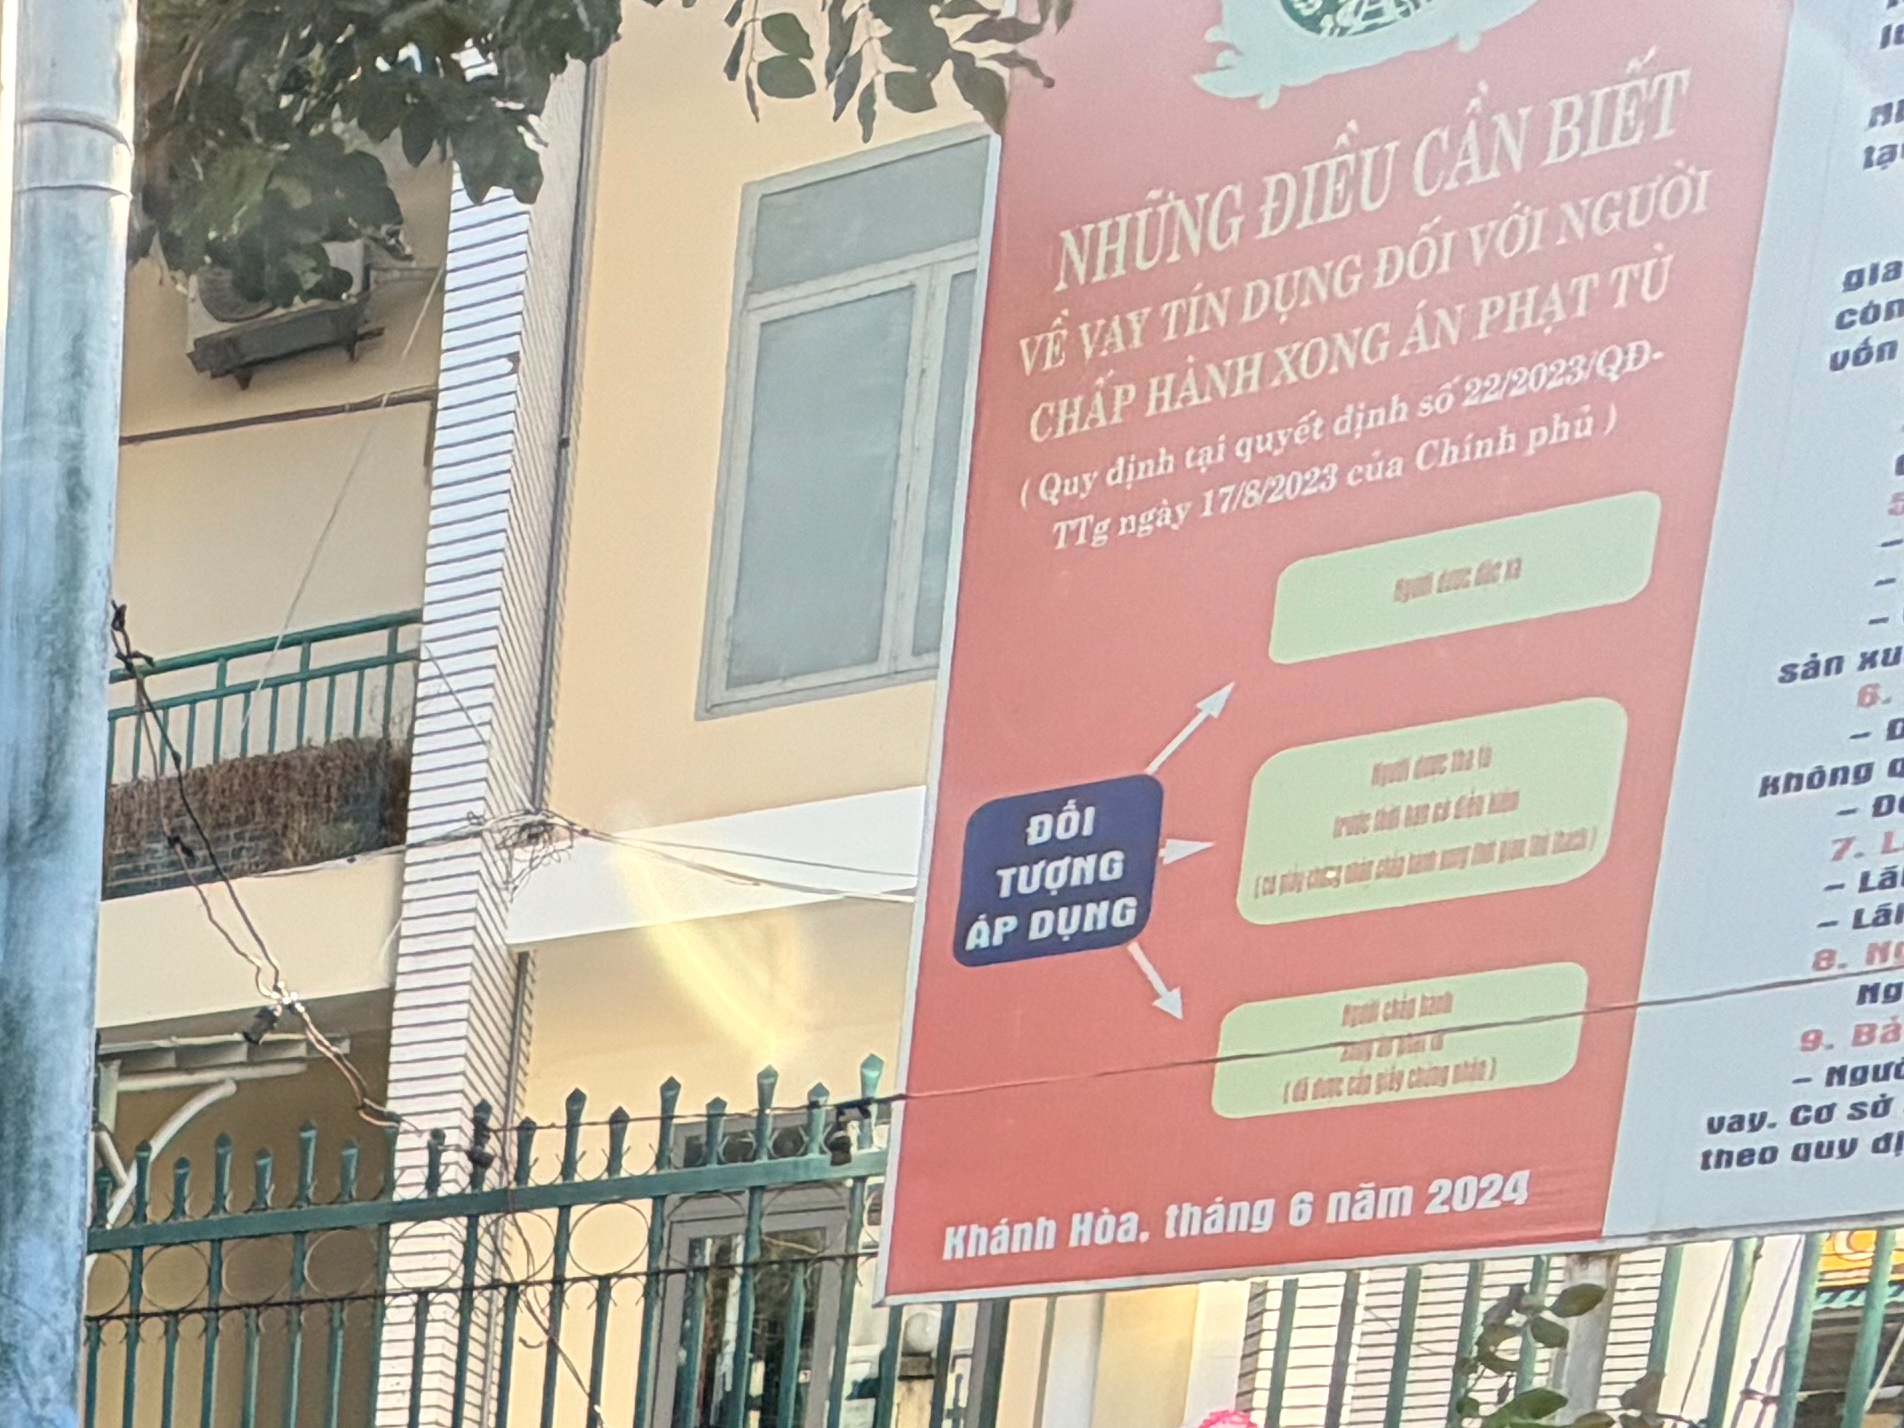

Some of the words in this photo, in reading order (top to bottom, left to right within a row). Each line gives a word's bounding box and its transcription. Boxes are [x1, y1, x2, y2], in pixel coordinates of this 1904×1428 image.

[1054, 181, 1244, 291] NHỮNG
[1256, 119, 1399, 240] ĐIỀU
[1413, 80, 1532, 197] CẦN
[1543, 46, 1692, 166] BIẾT
[1018, 306, 1071, 376] VỀ
[1080, 307, 1150, 366] VAY
[1161, 274, 1233, 345] TÍN
[1239, 254, 1365, 326] DỤNG
[1373, 215, 1455, 290] ĐỐI
[1464, 200, 1546, 268] VỚI
[1556, 159, 1713, 246] NGƯỜI
[1028, 368, 1136, 444] CHẤP
[1144, 354, 1263, 421] HÀNH
[1269, 321, 1392, 389] XONG
[1398, 300, 1467, 359] ÁN
[1476, 274, 1600, 342] PHẠT
[1610, 243, 1676, 309] TÙ
[1038, 469, 1099, 508] Quy
[1106, 444, 1175, 491] định
[1184, 438, 1226, 478] tại
[1235, 416, 1326, 463] quyết
[1333, 393, 1409, 444] định
[1417, 379, 1456, 421] số
[1462, 337, 1664, 409] 22/2023/QĐ-
[1052, 512, 1110, 550] TTg
[1118, 501, 1189, 540] ngày
[1199, 466, 1340, 519] 17/8/2023
[1345, 450, 1403, 490] của
[1414, 424, 1516, 473] Chính
[1527, 403, 1595, 449] phủ
[1778, 652, 1844, 684] sản
[1026, 799, 1096, 846] ĐỐI
[996, 850, 1125, 898] TƯỢNG
[965, 913, 1019, 950] ÁP
[1028, 896, 1138, 942] DỤNG
[1790, 1102, 1837, 1126] Cơ
[1847, 1093, 1894, 1120] sở
[1700, 1145, 1780, 1171] theo
[1791, 1137, 1859, 1163] quy
[943, 1217, 1056, 1260] Khánh
[1163, 1194, 1276, 1240] tháng
[1289, 1190, 1311, 1227] 6
[1325, 1181, 1413, 1225] năm
[1424, 1169, 1532, 1216] 2024
